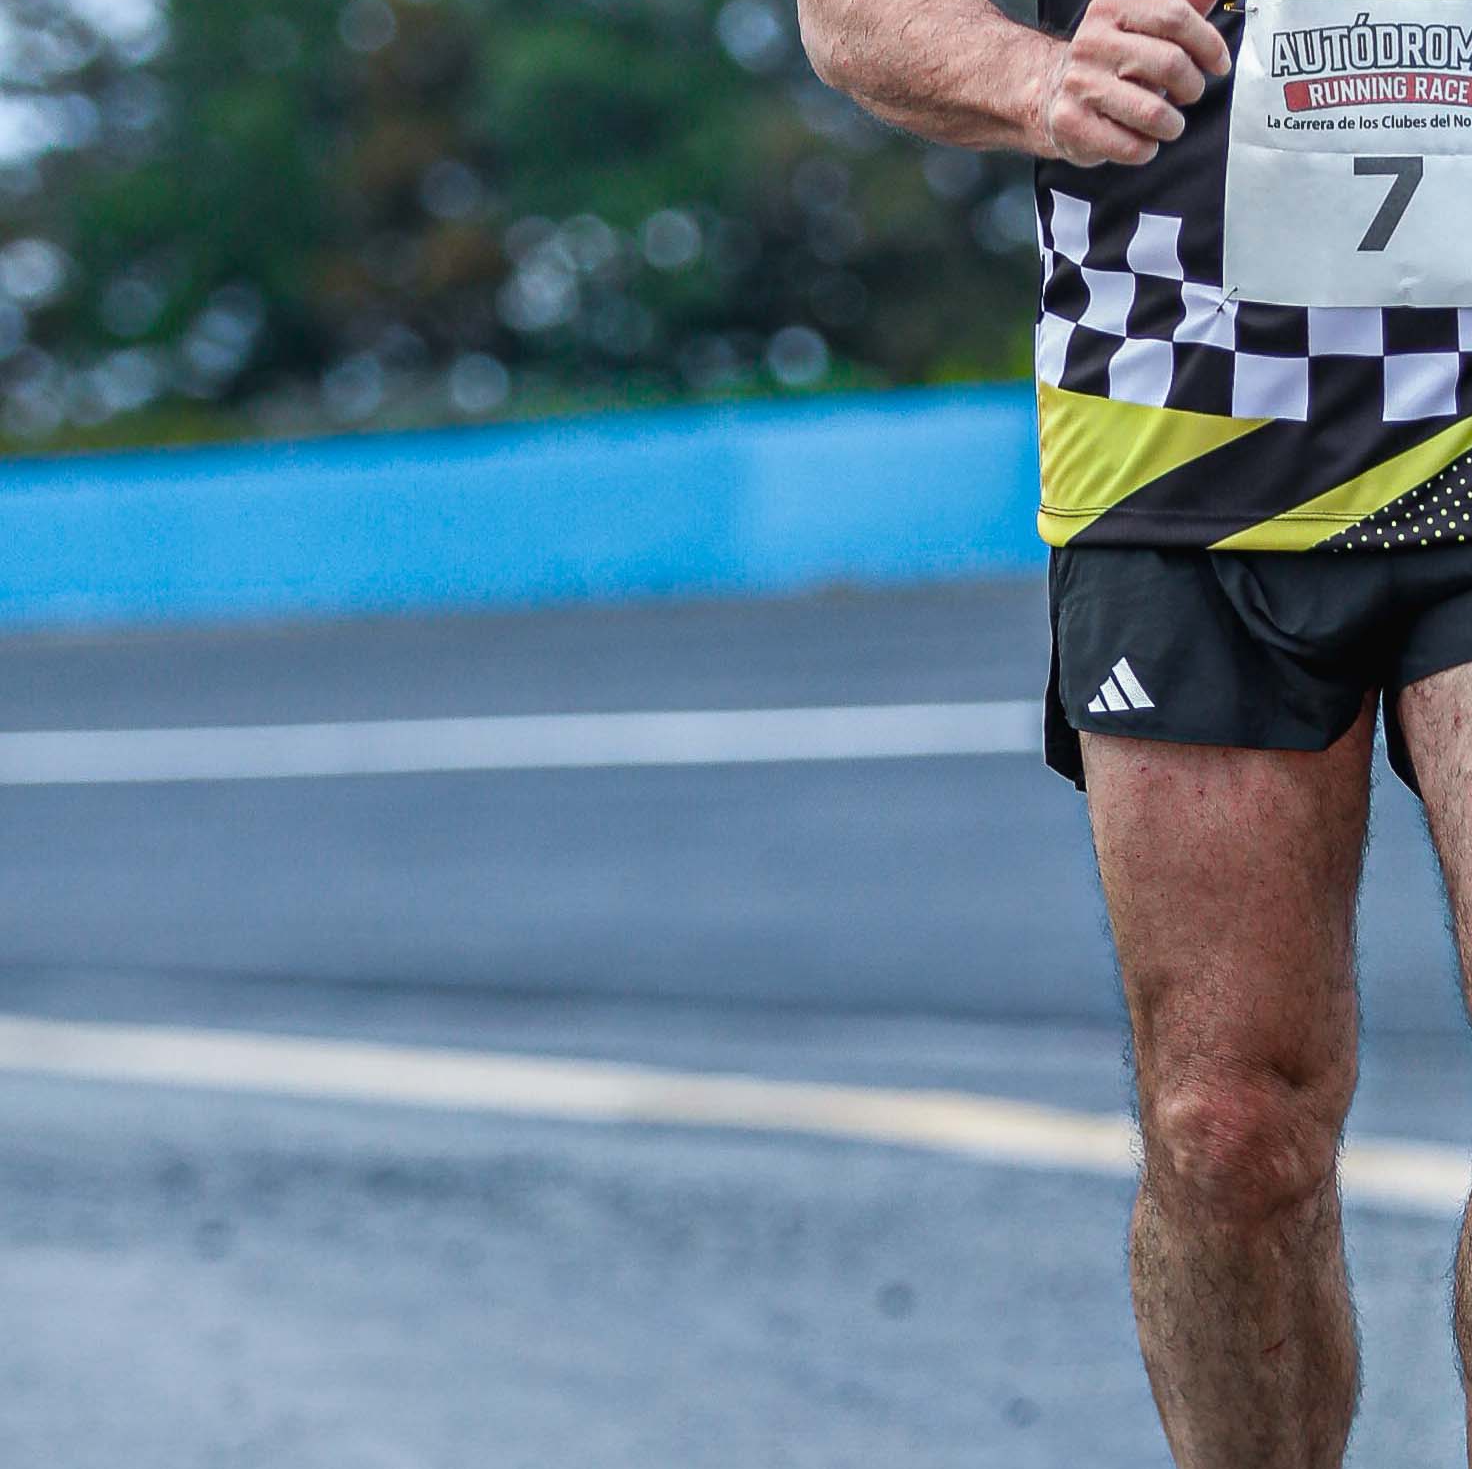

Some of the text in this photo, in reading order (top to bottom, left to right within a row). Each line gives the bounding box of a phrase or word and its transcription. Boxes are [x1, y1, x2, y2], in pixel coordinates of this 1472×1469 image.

[1308, 76, 1470, 107] RUNNING RACE
[1267, 114, 1281, 129] La
[1283, 116, 1335, 130] Carrera
[1338, 116, 1356, 130] de
[1359, 115, 1379, 129] los
[1382, 114, 1427, 129] Clubes
[1430, 114, 1451, 128] del
[1353, 156, 1424, 252] 7
